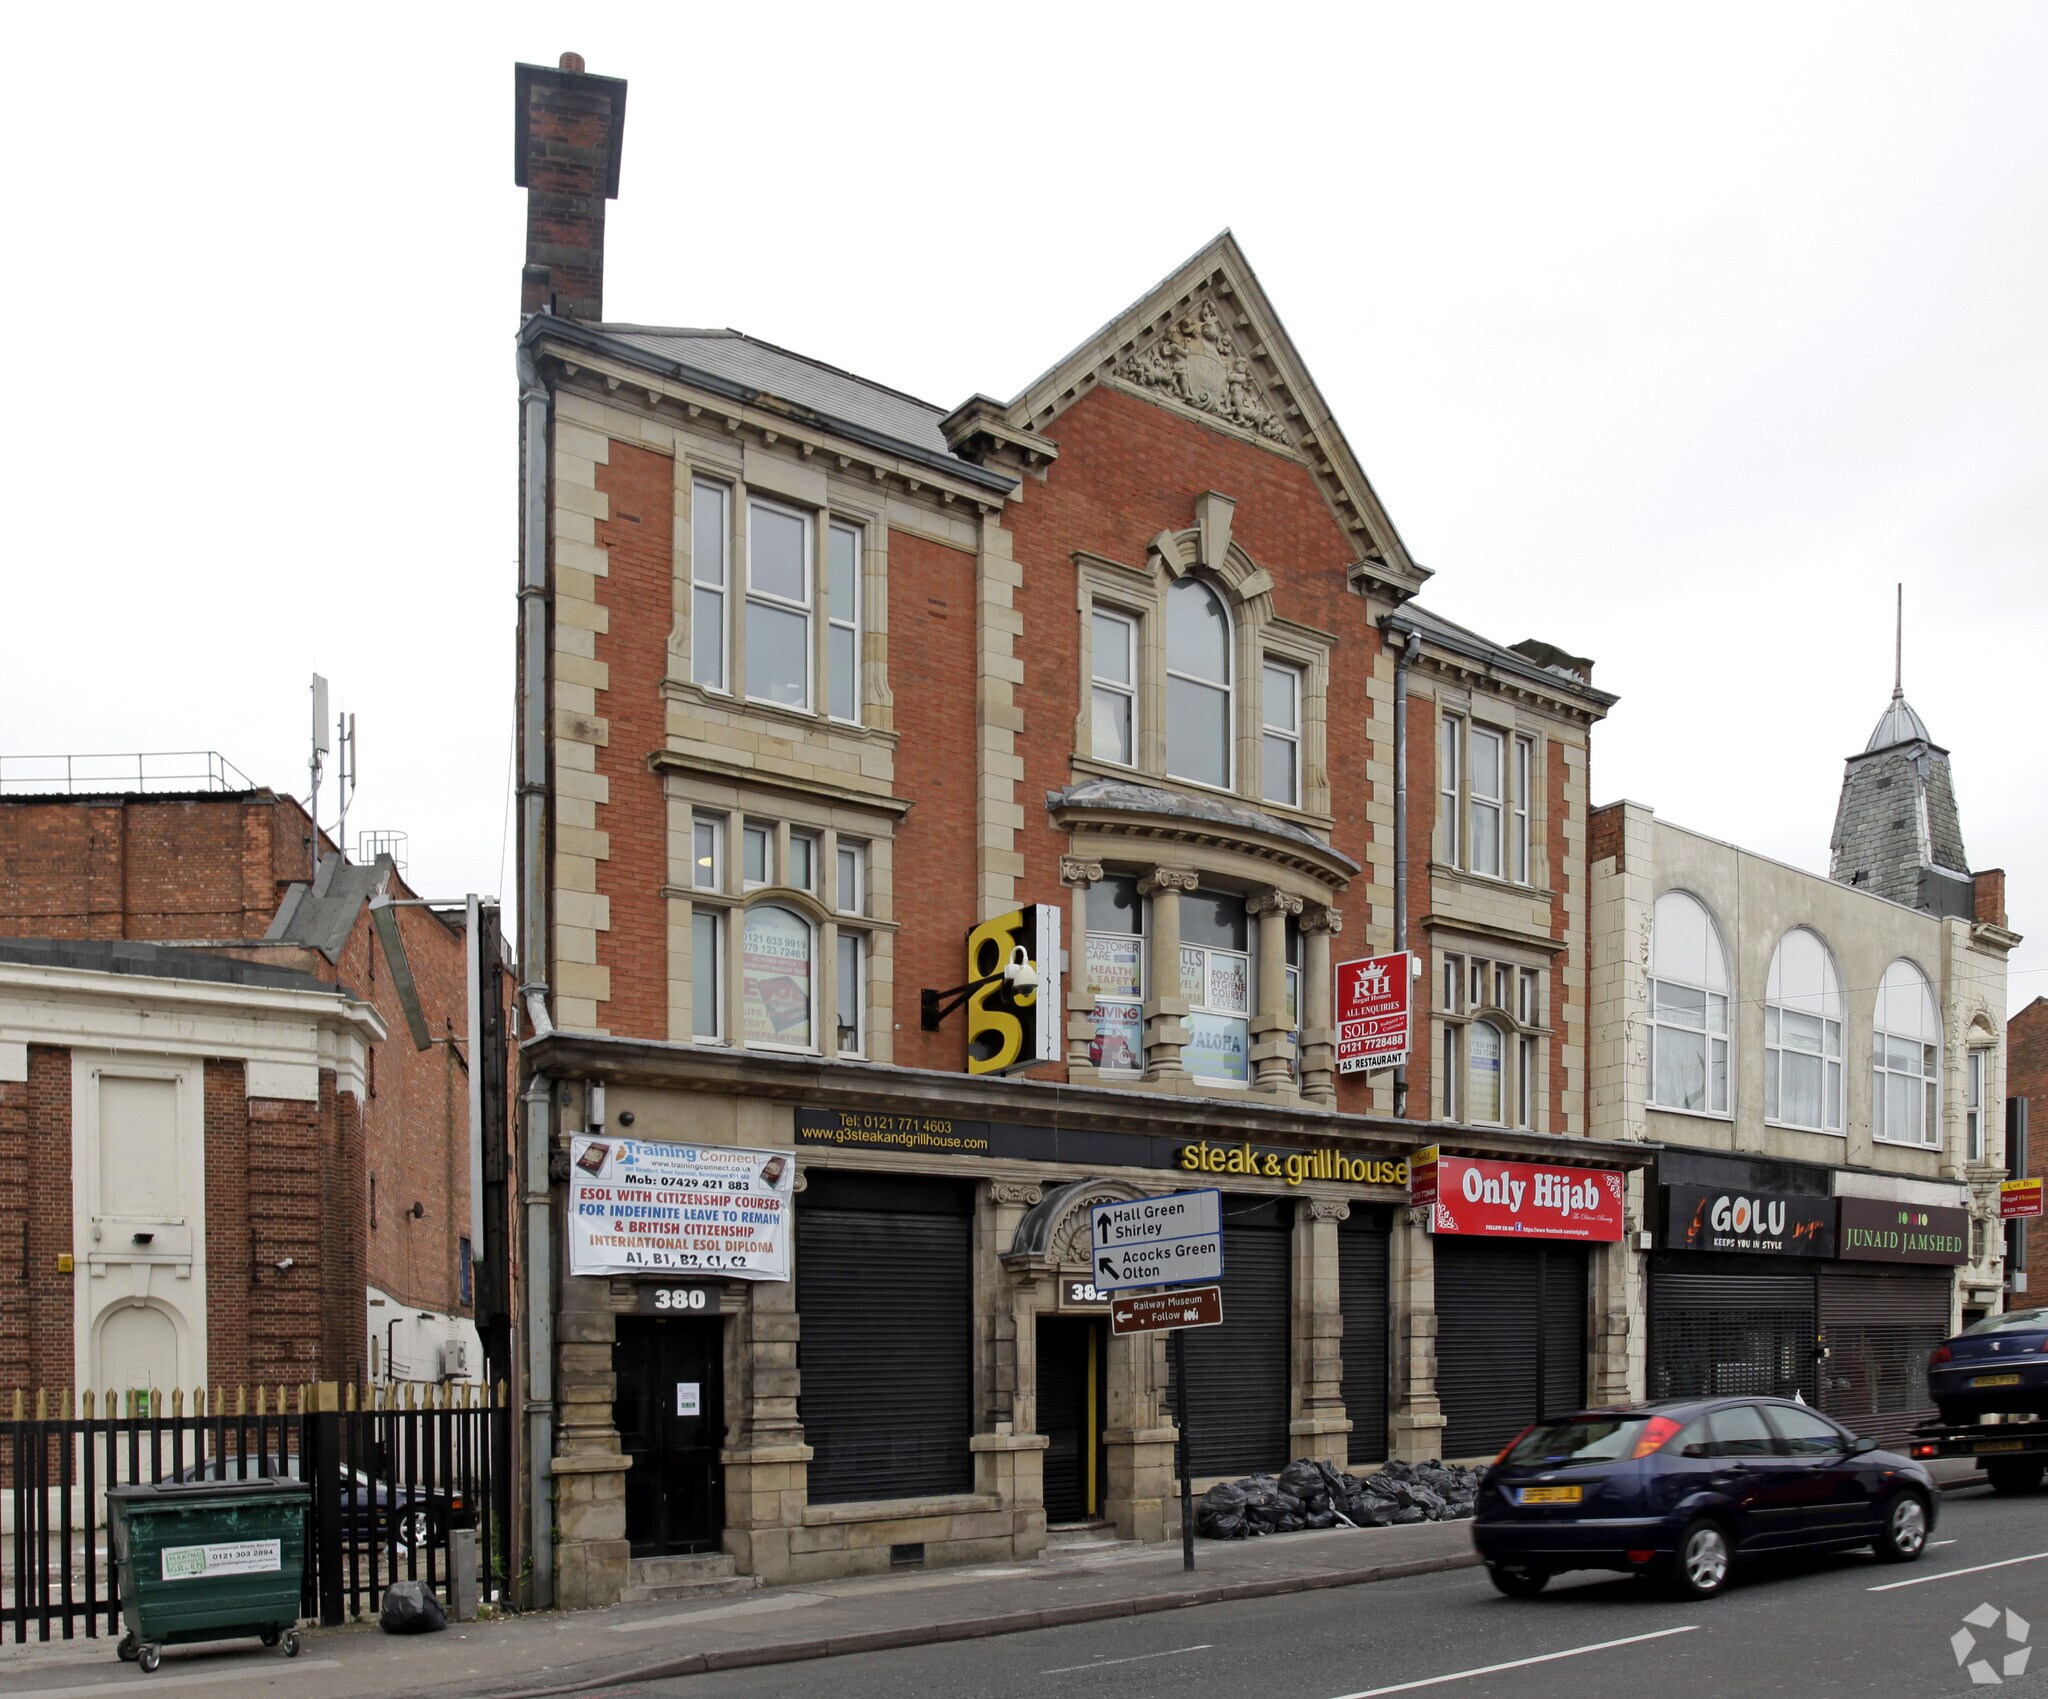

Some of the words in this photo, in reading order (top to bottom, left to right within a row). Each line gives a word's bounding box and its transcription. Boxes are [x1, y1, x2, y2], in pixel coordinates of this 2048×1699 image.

[767, 937, 782, 946] 633
[785, 939, 805, 949] 9919
[1086, 940, 1138, 953] CUSTOMER
[762, 946, 777, 955] 123
[780, 948, 805, 958] 72461
[1086, 950, 1111, 961] CARE
[1091, 965, 1131, 975] HEALTH
[1212, 970, 1235, 980] FOOD
[1087, 974, 1093, 982] &
[1097, 976, 1135, 985] SAFETY
[1211, 979, 1245, 991] HYGIENE
[1353, 976, 1391, 998] RH
[1212, 988, 1243, 1000] COURSE
[1353, 996, 1369, 1004] Regal
[1371, 994, 1391, 1002] Homes
[1213, 998, 1235, 1008] LEVEL
[1238, 1001, 1242, 1009] 2
[1346, 1009, 1359, 1017] ALL
[1362, 1001, 1399, 1014] ENQUIRIES
[1093, 1006, 1138, 1019] RIVING
[1345, 1022, 1378, 1038] SOLD
[1196, 1032, 1240, 1052] ALOHA
[1341, 1042, 1361, 1053] 0121
[1365, 1035, 1402, 1050] 7728488
[1343, 1061, 1351, 1070] AS
[1356, 1053, 1402, 1068] RESTAURANT
[839, 1113, 860, 1127] Tel:
[864, 1115, 893, 1129] 0121
[898, 1118, 919, 1131] 771
[923, 1120, 951, 1133] 4603
[802, 1128, 987, 1149] www.g3steakandgrillhouse.com
[623, 1142, 696, 1162] Training
[700, 1150, 757, 1164] Connect
[1182, 1140, 1260, 1175] steak
[1262, 1153, 1282, 1176] &
[1285, 1149, 1409, 1186] grillhouse
[625, 1175, 656, 1185] Mob:
[662, 1177, 698, 1188] 07429
[703, 1180, 722, 1189] 421
[728, 1182, 749, 1190] 883
[580, 1188, 612, 1200] ESOL
[617, 1190, 651, 1203] WITH
[656, 1192, 730, 1207] CITIZENSHIP
[735, 1197, 780, 1210] COURSES
[1462, 1168, 1526, 1213] Only
[1534, 1173, 1599, 1217] Hijab
[579, 1204, 607, 1216] FOR
[610, 1205, 680, 1220] INDEFINITE
[684, 1208, 718, 1222] LEAVE
[723, 1210, 737, 1223] TO
[742, 1212, 780, 1225] REMAIN
[1114, 1208, 1140, 1223] Hall
[1145, 1204, 1184, 1218] Green
[1711, 1196, 1785, 1235] GOLU
[614, 1221, 623, 1233] &
[629, 1222, 680, 1234] BRITISH
[684, 1223, 754, 1238] CITIZENSHIP
[1116, 1223, 1162, 1238] Shirley
[590, 1234, 688, 1250] INTERNATIONAL
[693, 1239, 721, 1251] ESOL
[725, 1240, 773, 1254] DIPLOMA
[1714, 1238, 1735, 1247] KEEPS
[1737, 1240, 1750, 1248] YOU
[1753, 1240, 1760, 1248] IN
[1762, 1241, 1782, 1250] STYLE
[1846, 1228, 1898, 1250] JUNAID
[1902, 1233, 1962, 1254] JAMSHED
[626, 1252, 648, 1266] A1,
[654, 1253, 675, 1267] B1,
[680, 1254, 701, 1268] B2,
[707, 1255, 727, 1269] C1,
[731, 1256, 746, 1268] C2
[1123, 1247, 1170, 1263] Acocks
[1176, 1243, 1216, 1257] Green
[1123, 1266, 1160, 1280] Olton
[655, 1289, 705, 1309] 380
[1134, 1298, 1165, 1311] Railway
[1168, 1295, 1202, 1307] Museum
[1152, 1311, 1180, 1322] Follow
[169, 1552, 201, 1561] MAKING
